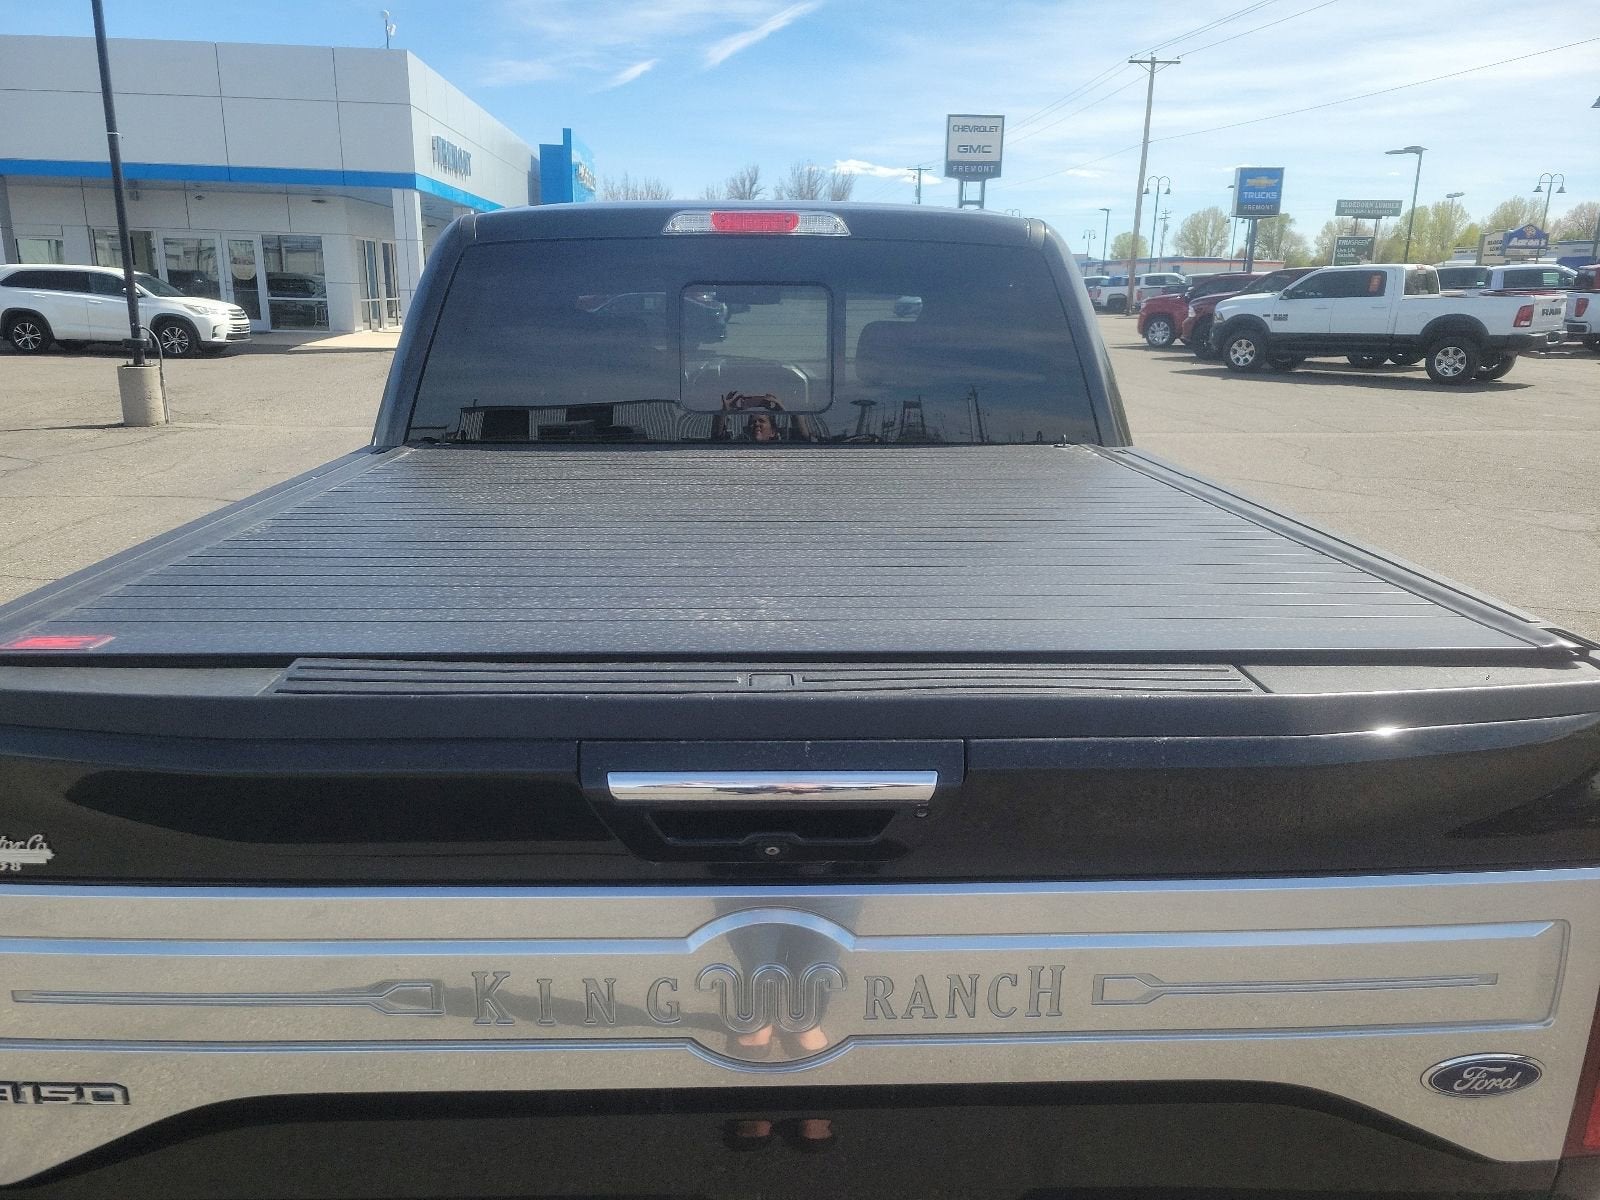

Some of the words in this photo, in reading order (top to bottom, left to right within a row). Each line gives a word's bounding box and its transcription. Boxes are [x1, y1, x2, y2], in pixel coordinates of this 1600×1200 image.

[952, 124, 1000, 133] CHEVROLET
[957, 144, 993, 154] GMC
[952, 165, 995, 173] FREMONT
[1243, 191, 1278, 199] TRUCKS
[471, 970, 682, 1026] KING
[862, 964, 1066, 1020] RANCH
[1453, 1066, 1522, 1091] Ford
